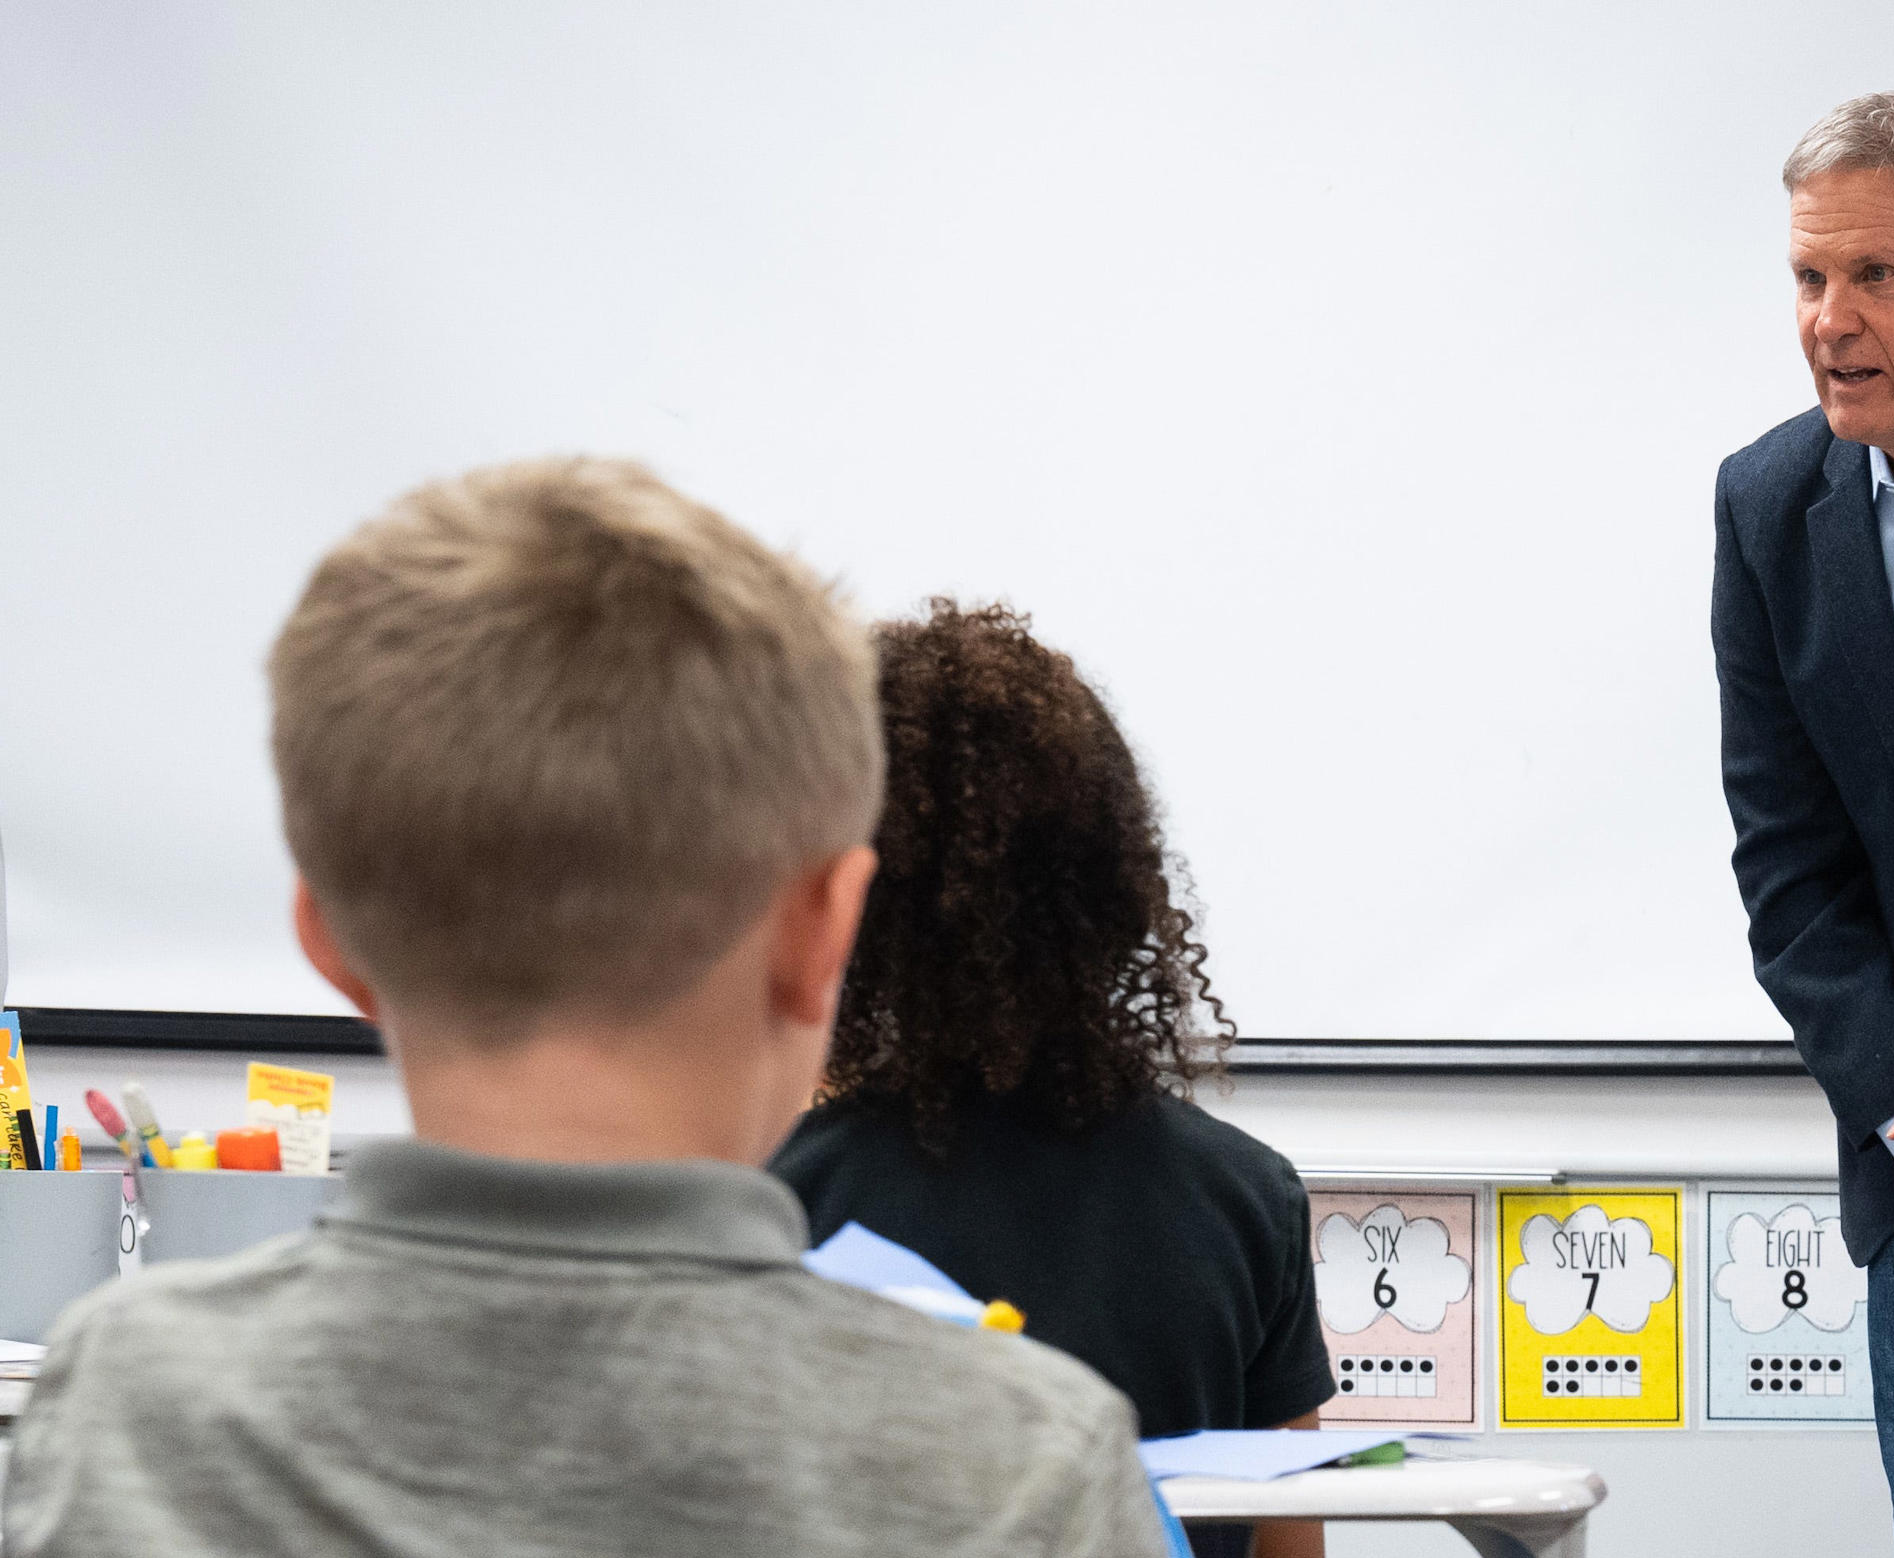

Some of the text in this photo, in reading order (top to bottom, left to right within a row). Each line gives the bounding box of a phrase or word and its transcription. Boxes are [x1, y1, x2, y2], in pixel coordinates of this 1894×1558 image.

[1363, 1225, 1402, 1264] SIX
[1552, 1231, 1627, 1270] SEVEN
[1766, 1229, 1825, 1269] EIGHT
[1373, 1267, 1397, 1309] 6
[1581, 1272, 1600, 1310] 7
[1782, 1269, 1808, 1309] 8
